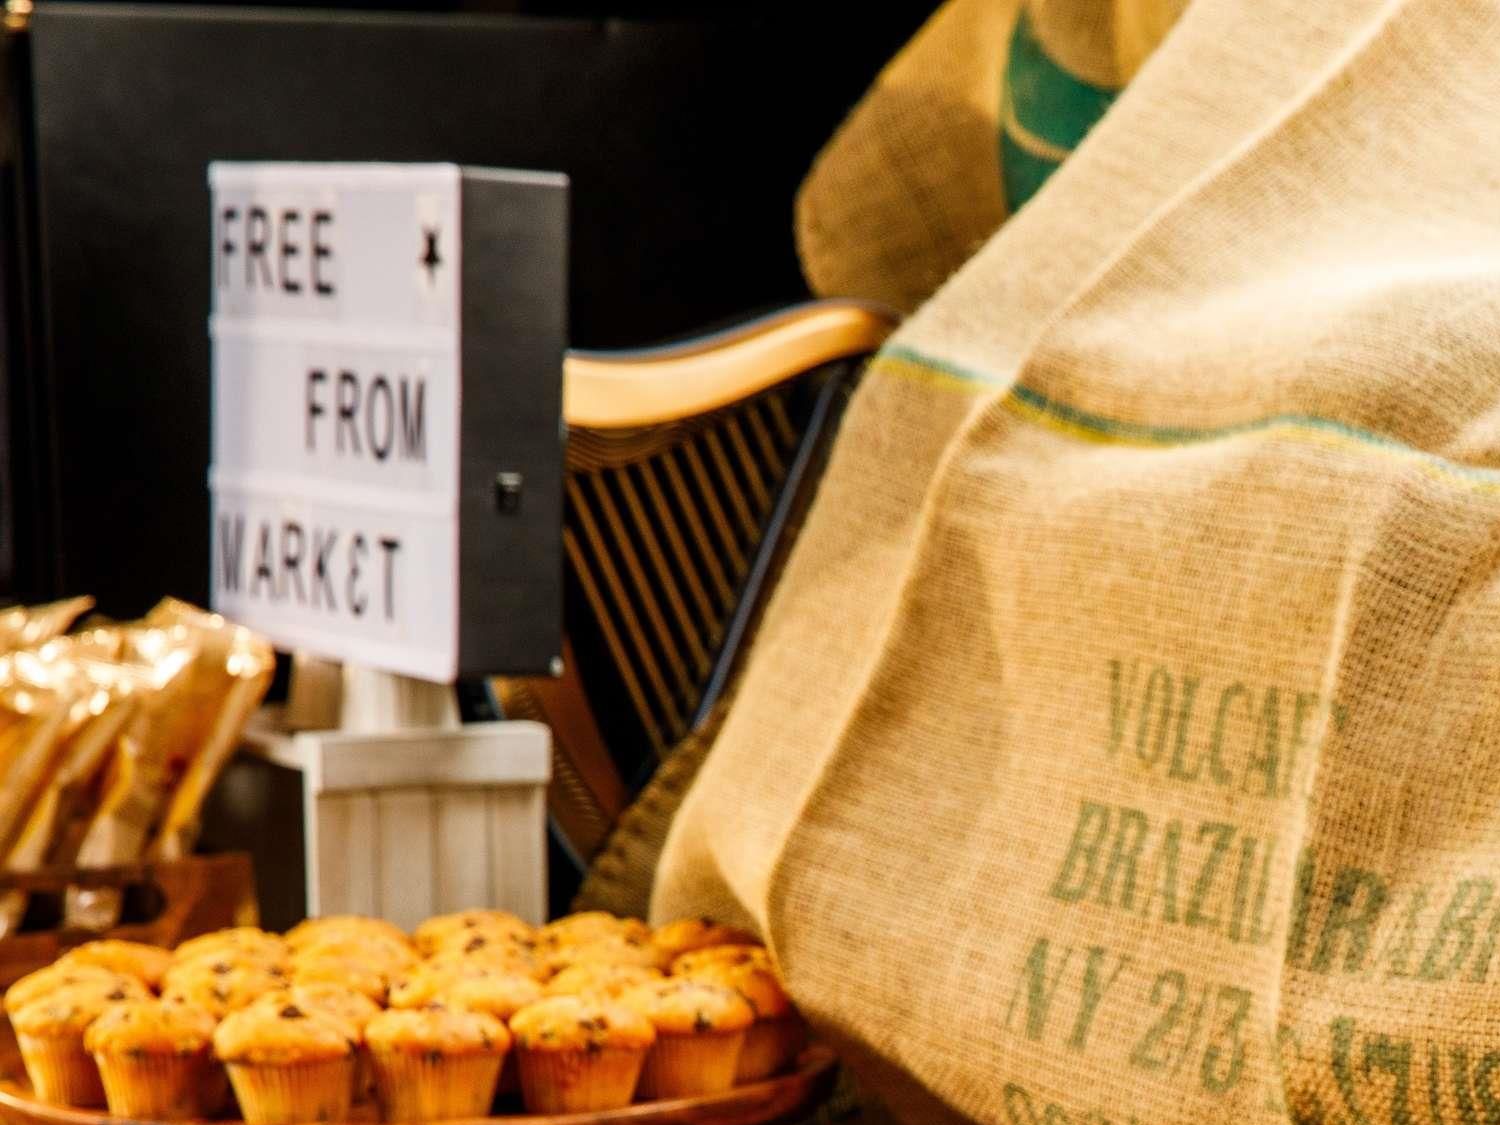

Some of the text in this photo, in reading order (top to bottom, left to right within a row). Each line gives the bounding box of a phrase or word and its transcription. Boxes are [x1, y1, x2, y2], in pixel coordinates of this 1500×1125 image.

[217, 207, 336, 296] FREE
[304, 369, 428, 464] FROM
[215, 512, 401, 623] MARKET
[1001, 937, 1124, 1052] NY
[1129, 969, 1254, 1095] 2/3
